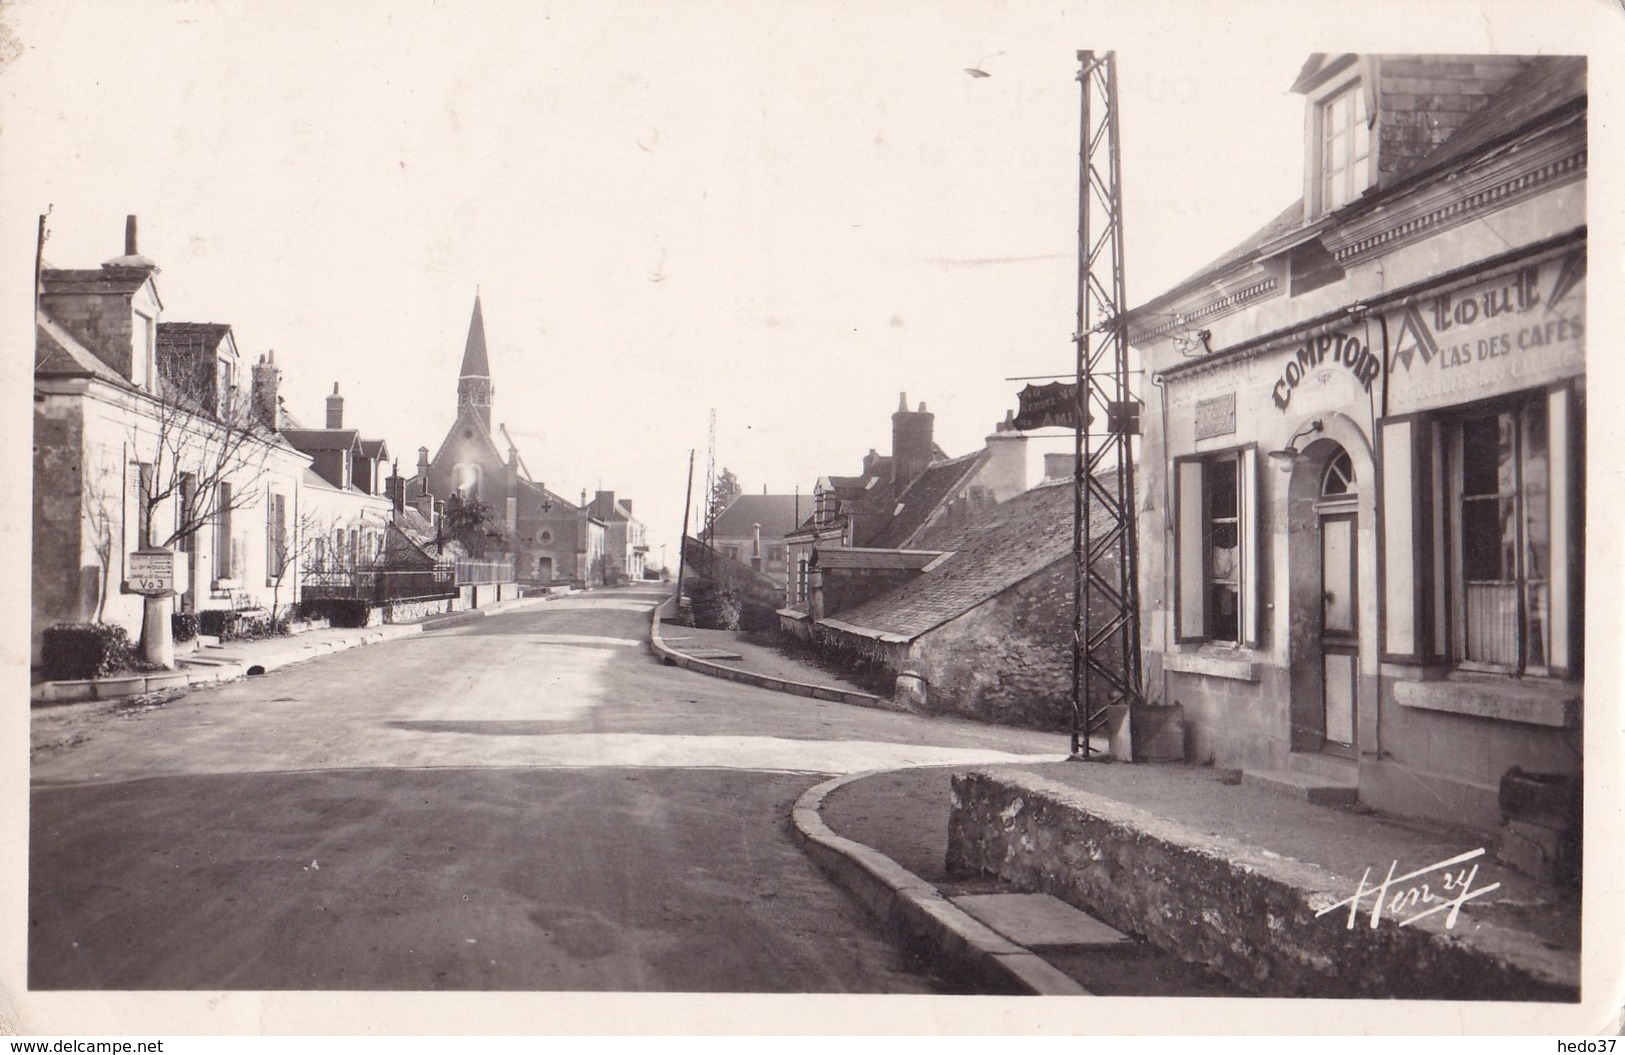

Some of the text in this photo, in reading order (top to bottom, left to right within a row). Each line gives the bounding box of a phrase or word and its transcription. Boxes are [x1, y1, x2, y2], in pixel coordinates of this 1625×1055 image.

[1440, 341, 1472, 370] L'AS
[1477, 336, 1511, 361] DES
[1272, 332, 1380, 414] COMPTOIR
[157, 580, 164, 588] 3
